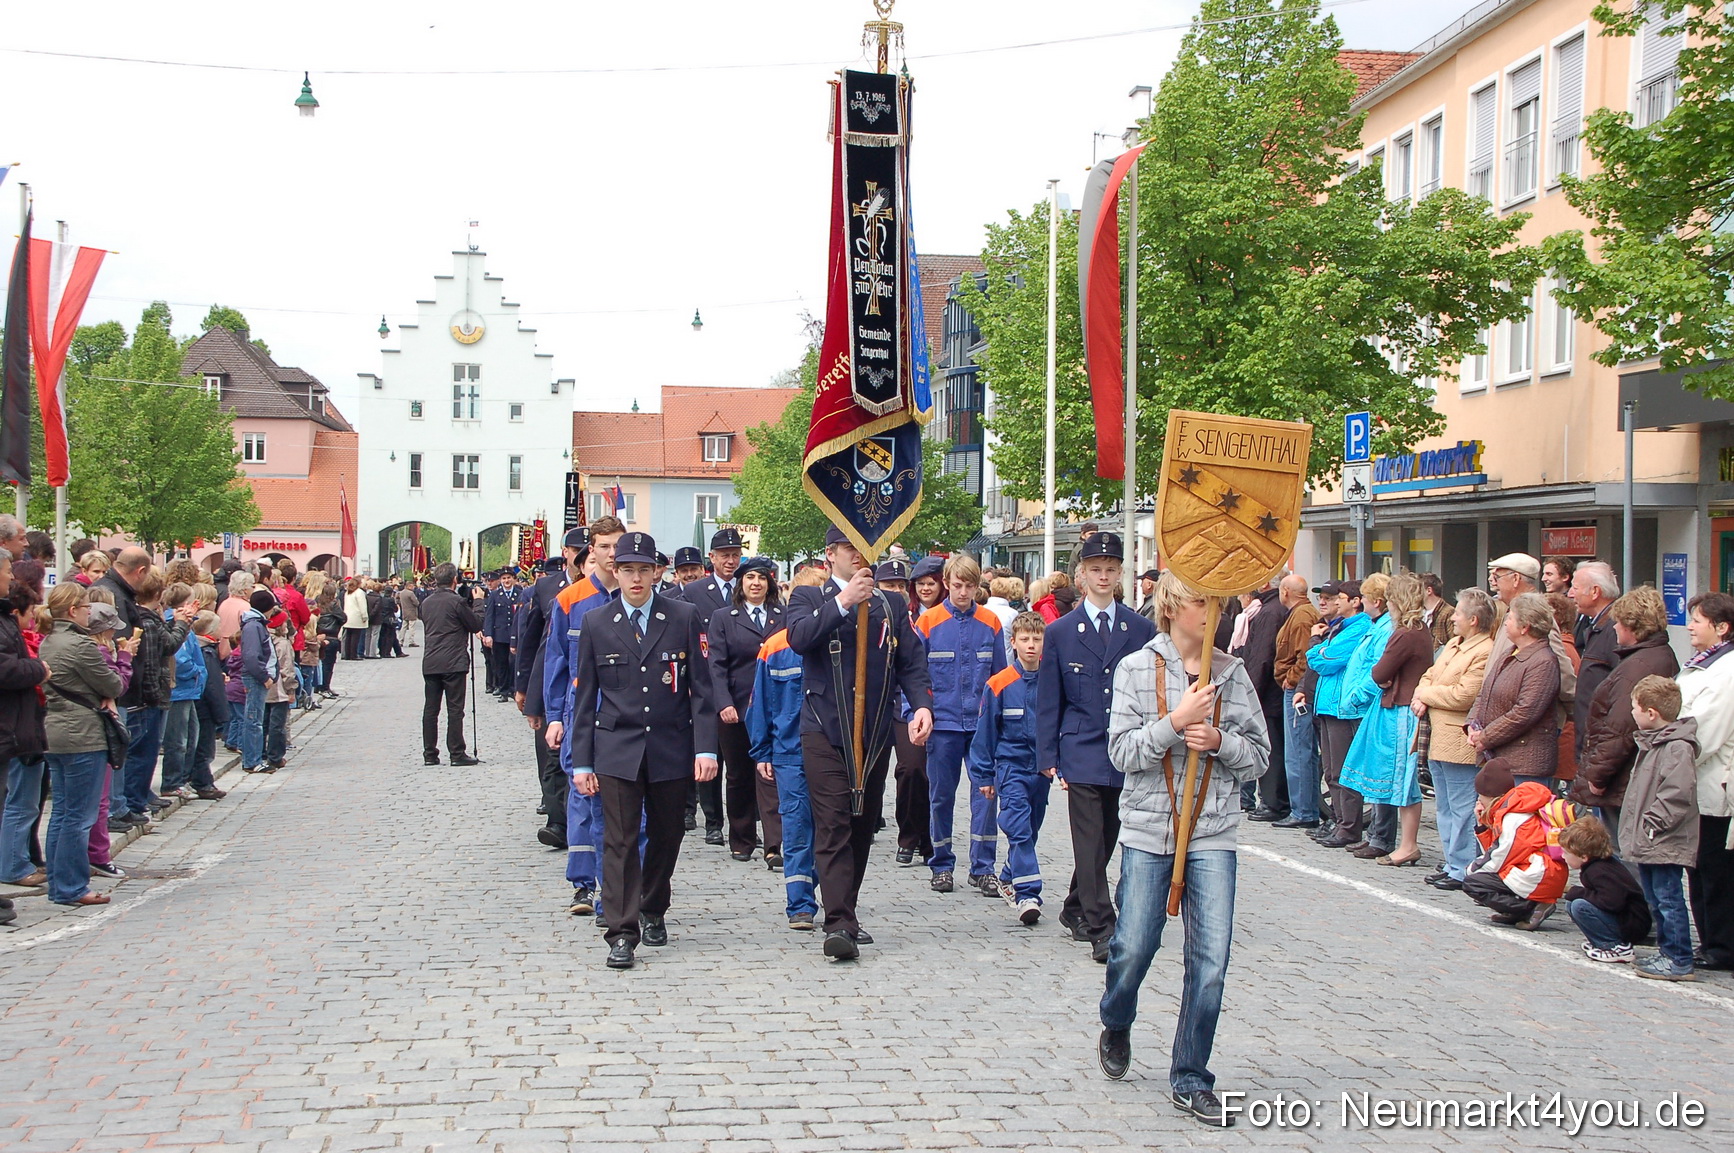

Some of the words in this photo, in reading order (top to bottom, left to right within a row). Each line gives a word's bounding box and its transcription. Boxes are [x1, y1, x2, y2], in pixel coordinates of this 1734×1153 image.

[859, 325, 892, 342] Gemeinde
[1193, 428, 1299, 465] SENGENTHAL
[1350, 419, 1365, 456] P
[243, 539, 307, 551] Sparkasse
[1549, 532, 1569, 553] Super
[1570, 532, 1594, 553] Kebap
